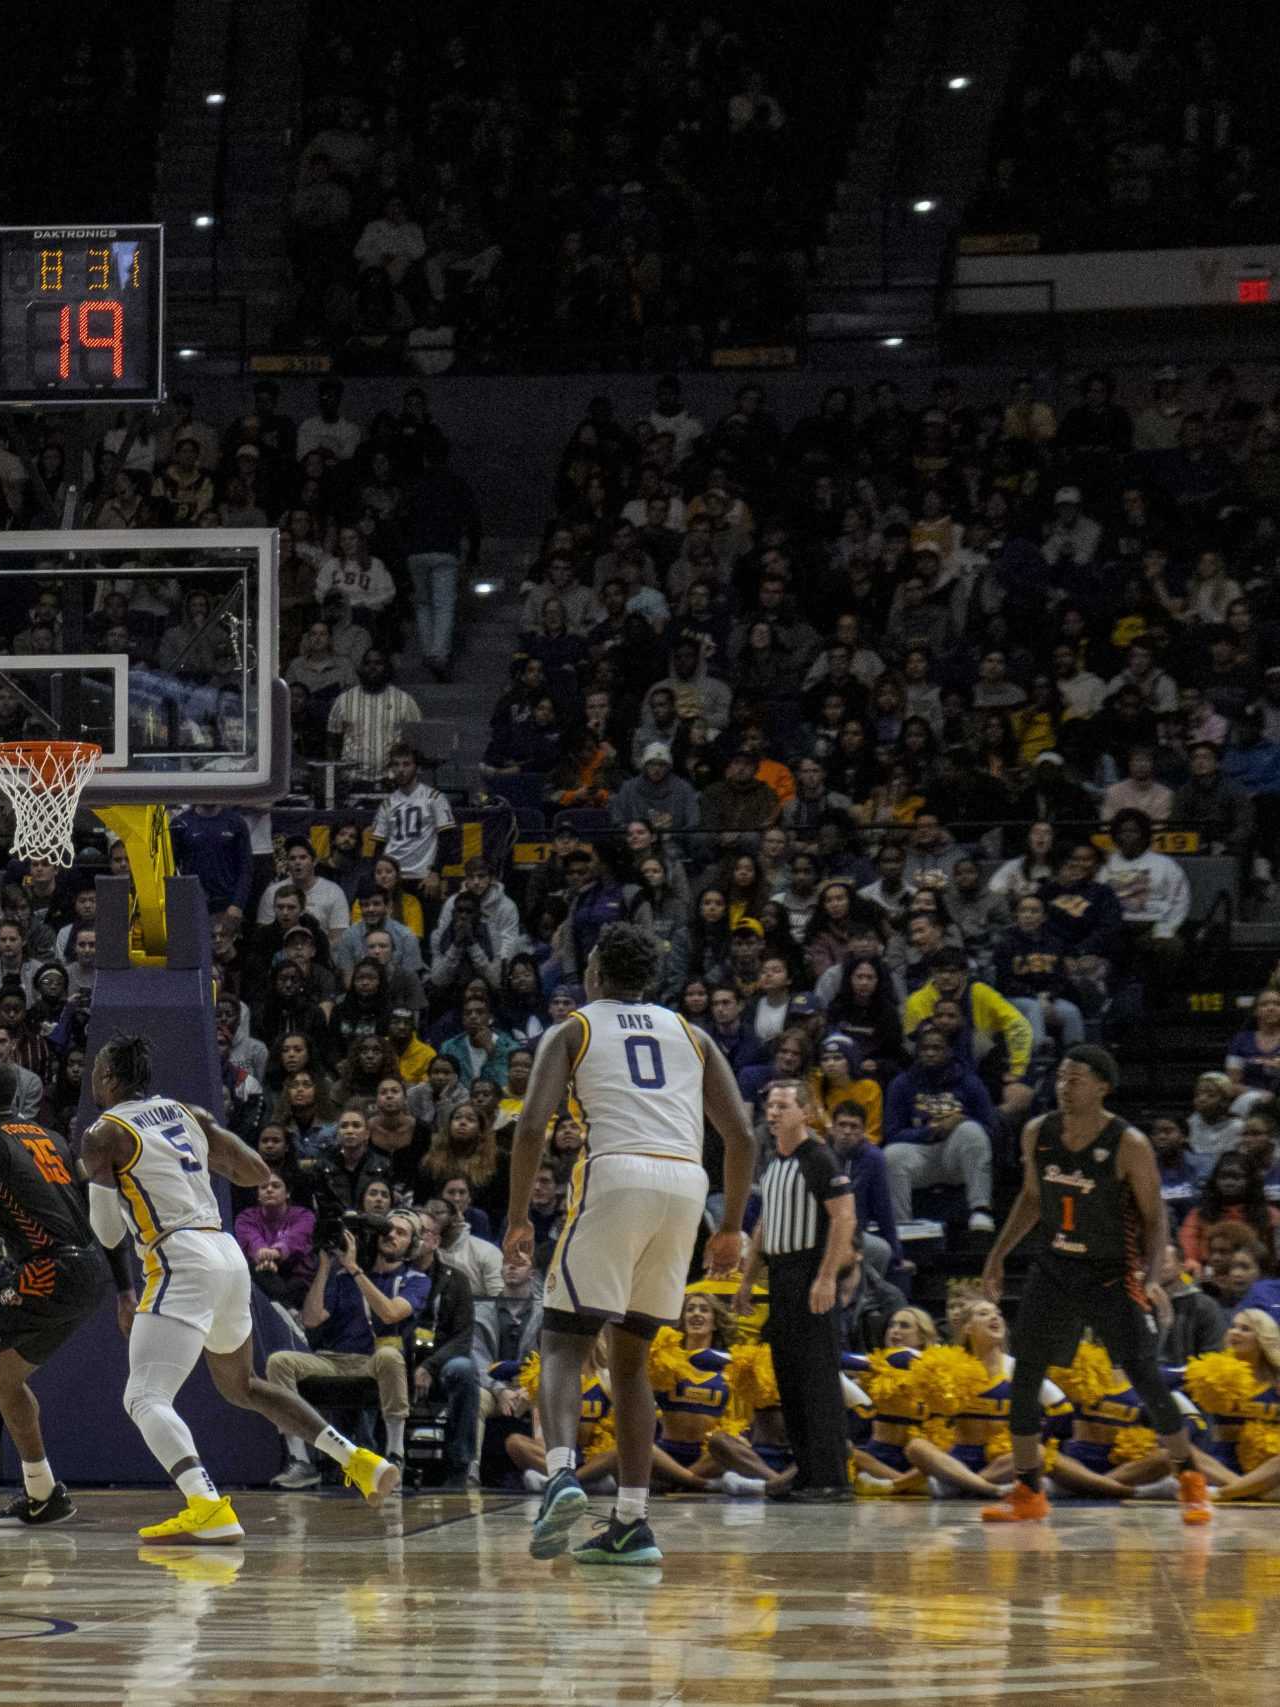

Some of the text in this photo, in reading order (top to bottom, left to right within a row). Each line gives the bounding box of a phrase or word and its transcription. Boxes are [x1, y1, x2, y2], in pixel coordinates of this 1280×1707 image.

[33, 230, 117, 239] DAKTRONICS
[58, 300, 123, 380] 19
[394, 807, 422, 841] 10
[617, 1014, 653, 1030] DAYS
[624, 1036, 666, 1089] 0
[131, 1104, 184, 1129] WILLIAMS
[160, 1124, 202, 1171] 5
